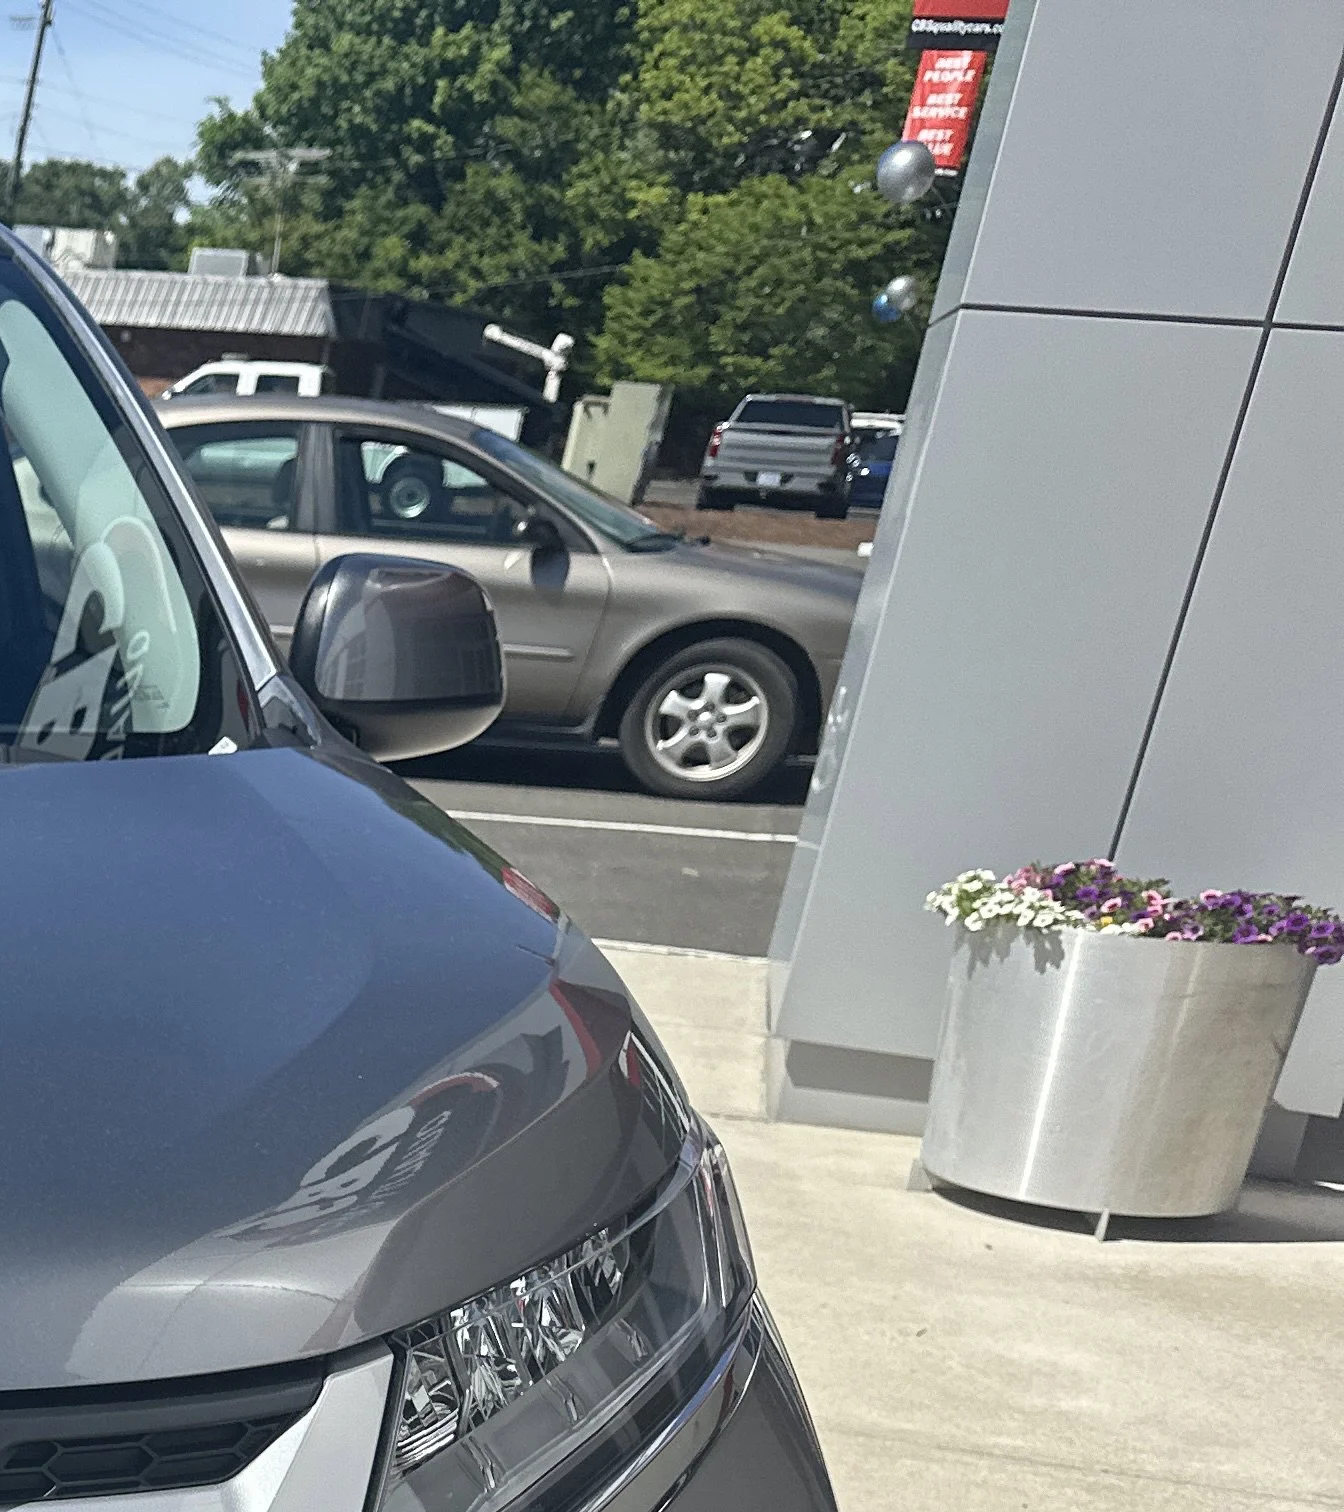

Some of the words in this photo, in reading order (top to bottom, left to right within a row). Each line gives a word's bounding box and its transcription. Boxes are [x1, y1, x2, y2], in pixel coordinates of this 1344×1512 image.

[912, 19, 1003, 36] CBSqualitycars.co
[923, 69, 976, 82] PEOPLE
[912, 106, 968, 119] SERVICE
